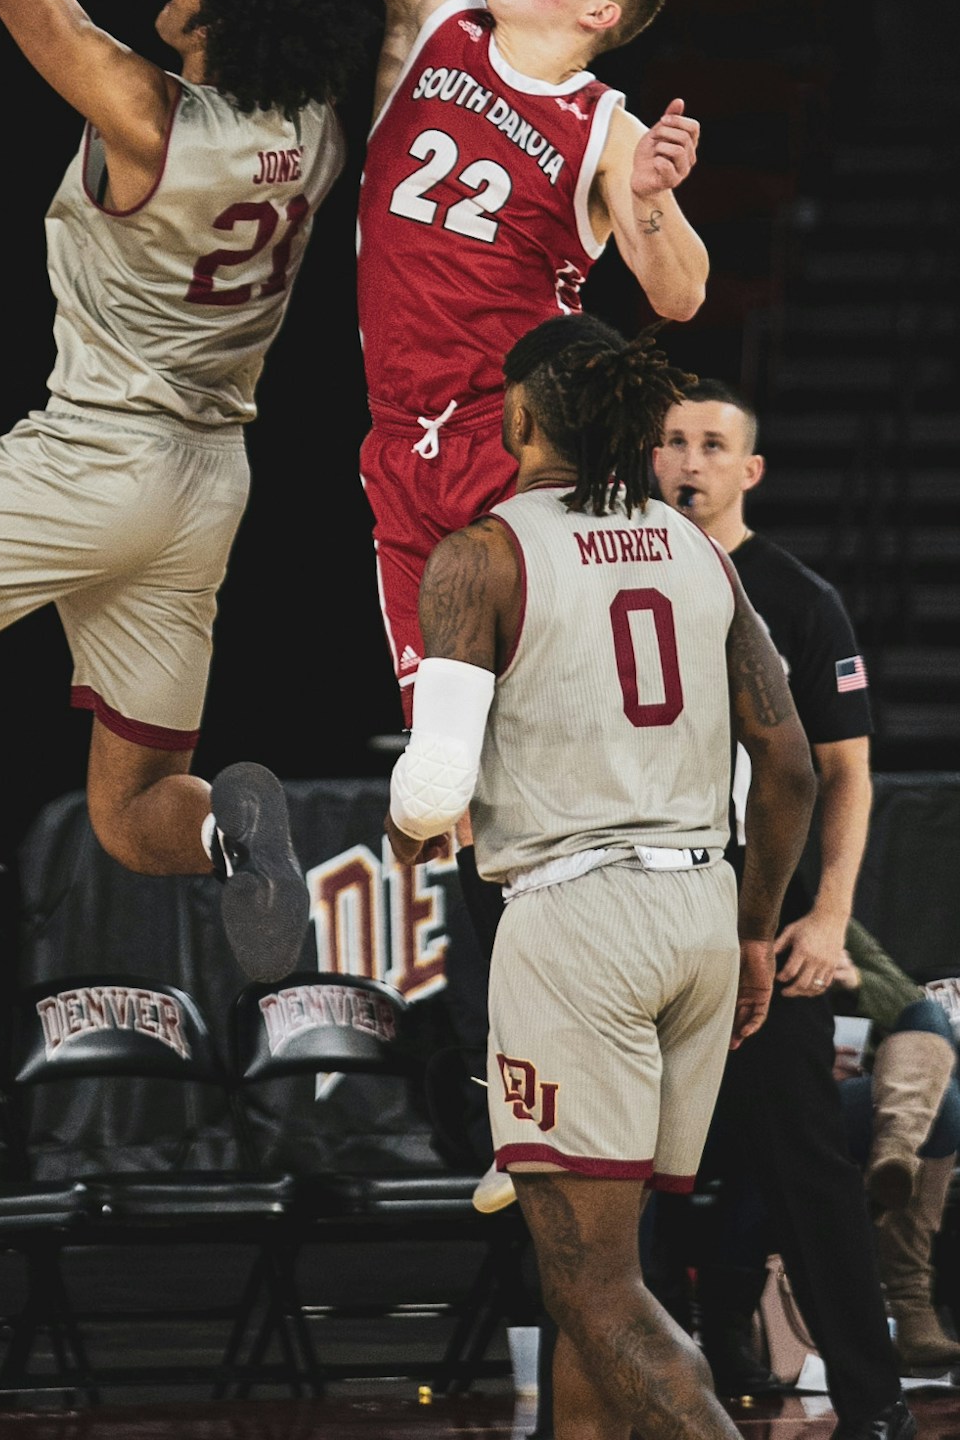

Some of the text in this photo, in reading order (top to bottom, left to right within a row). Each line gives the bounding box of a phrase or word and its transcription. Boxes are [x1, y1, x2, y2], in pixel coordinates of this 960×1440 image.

[412, 67, 493, 114] SOUTH
[252, 145, 305, 185] JONE
[390, 128, 513, 244] 22
[182, 193, 310, 306] 21
[573, 527, 674, 565] MURKEY
[609, 587, 684, 728] 0
[36, 985, 192, 1061] DENVER
[258, 985, 397, 1058] DENVER
